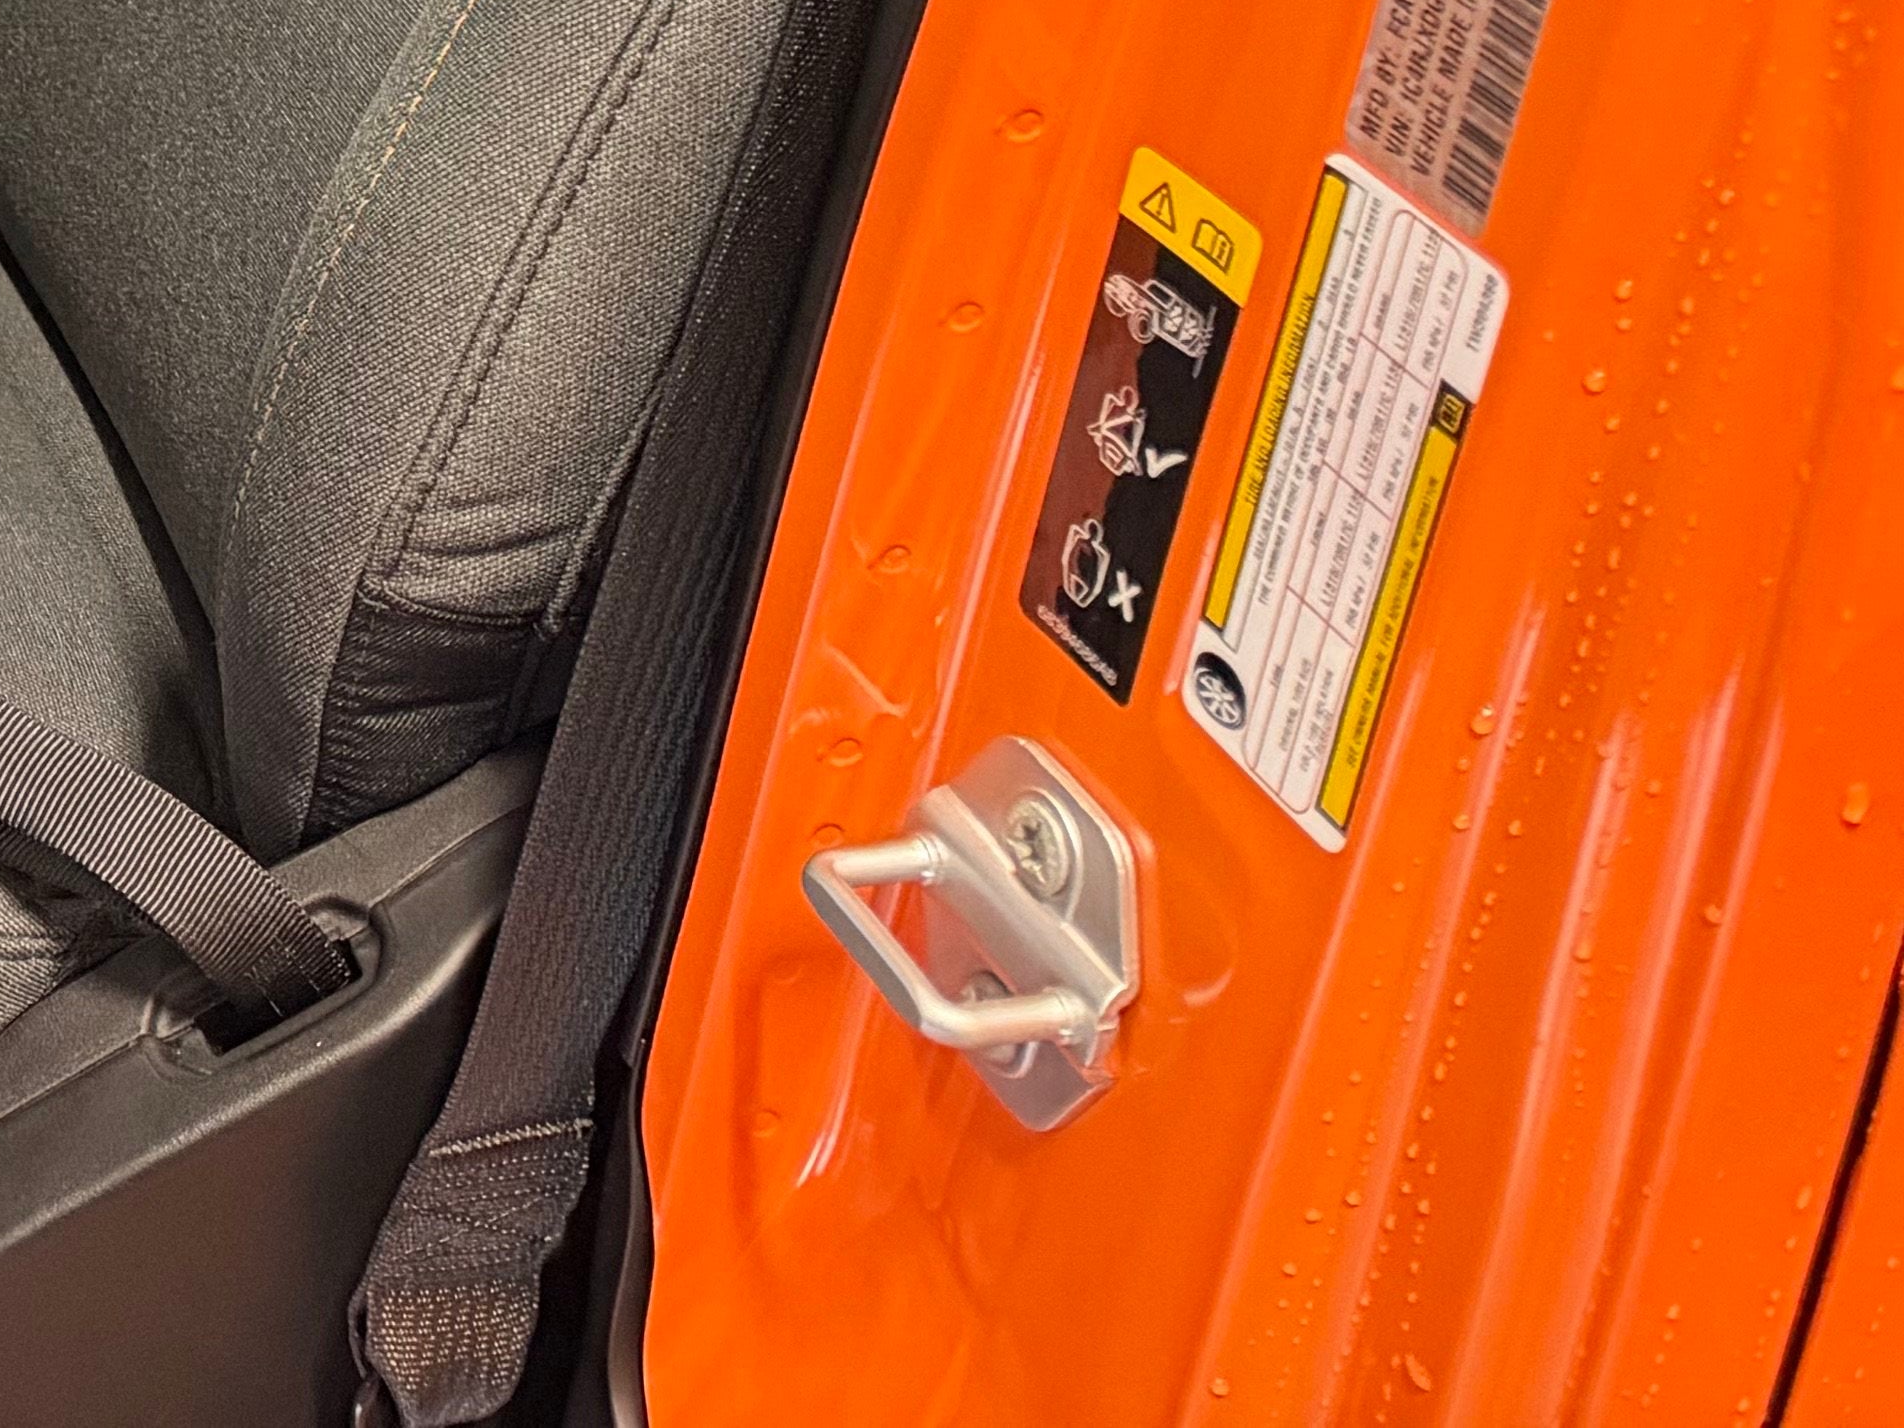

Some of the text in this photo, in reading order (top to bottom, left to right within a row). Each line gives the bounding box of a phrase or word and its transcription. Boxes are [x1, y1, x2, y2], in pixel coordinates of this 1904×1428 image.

[1359, 85, 1389, 143] MFD
[1385, 108, 1414, 162] VIN:
[1410, 81, 1452, 180] VEHICLE
[1435, 10, 1470, 83] MADE
[1244, 290, 1313, 508] TIRE AND LOADING INFORMATION
